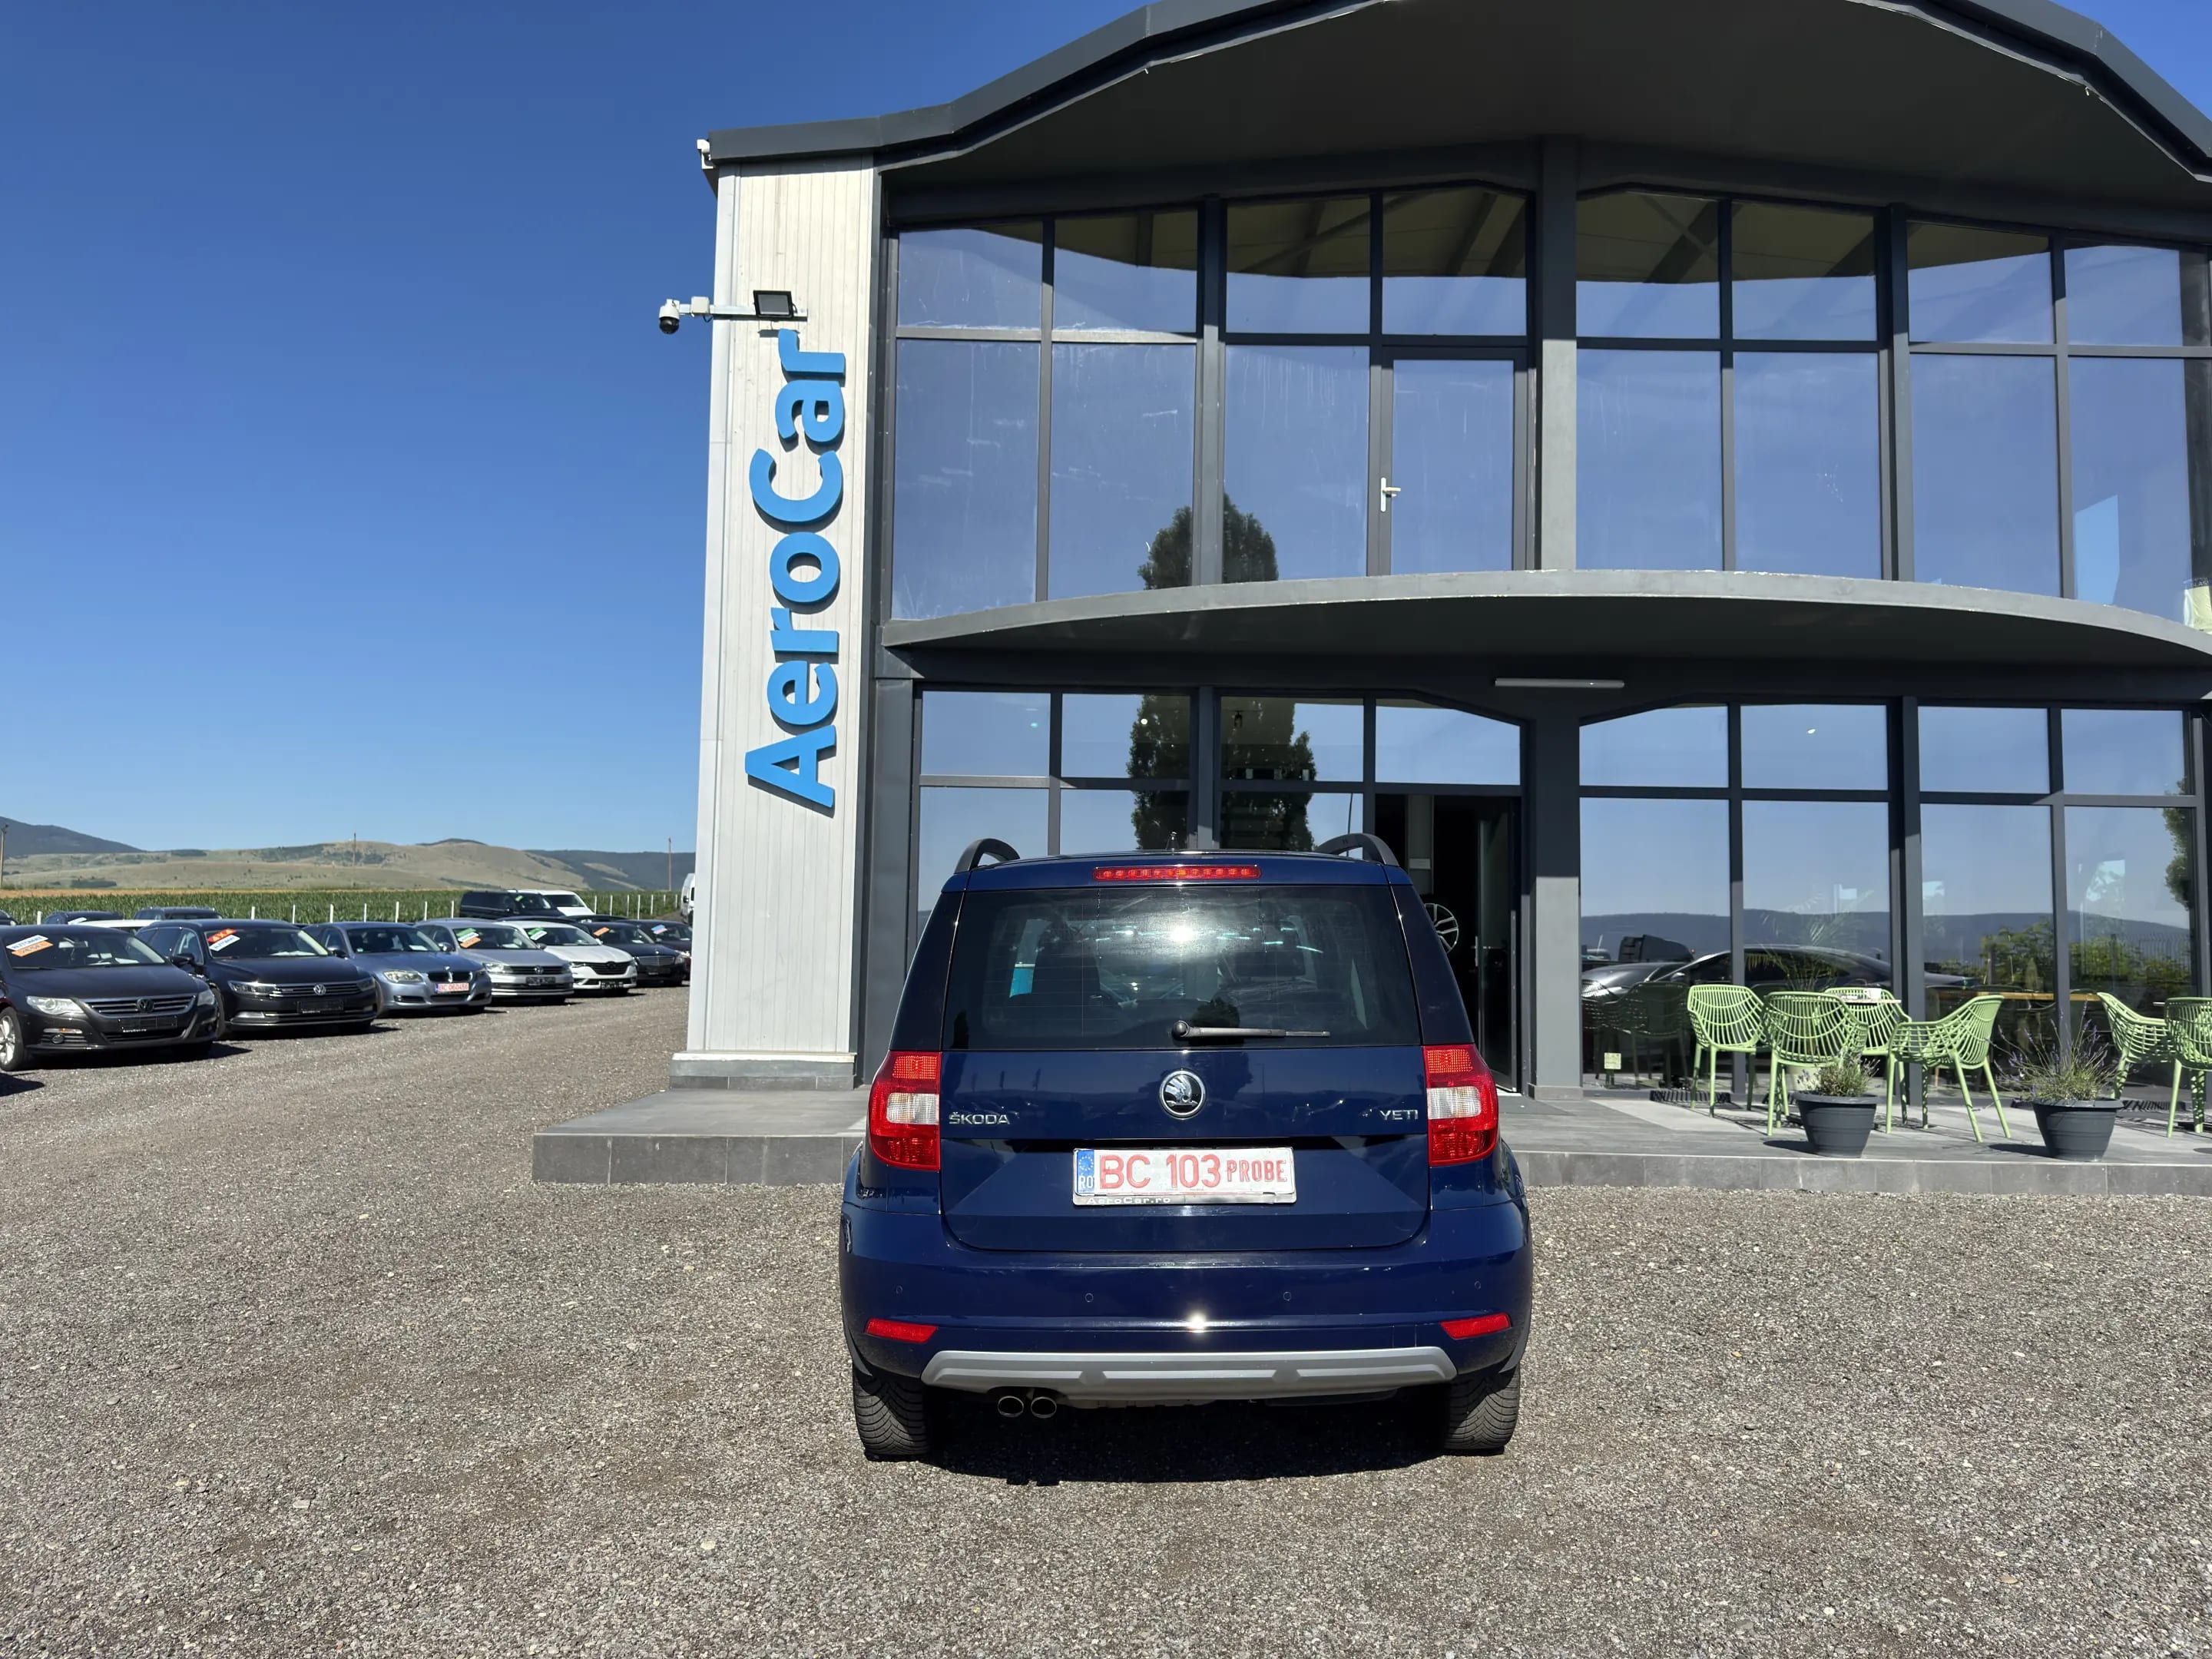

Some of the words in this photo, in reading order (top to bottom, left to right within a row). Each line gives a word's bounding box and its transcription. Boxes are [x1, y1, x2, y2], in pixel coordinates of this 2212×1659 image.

[745, 329, 846, 808] AeroCar
[949, 1111, 1011, 1124] ŠKODA
[1379, 1109, 1419, 1121] YETI
[1099, 1154, 1151, 1190] BC
[1165, 1154, 1222, 1188] 103
[1226, 1159, 1288, 1183] PROBE
[1078, 1175, 1094, 1189] RO
[1086, 1197, 1171, 1205] AeroCar.ro
